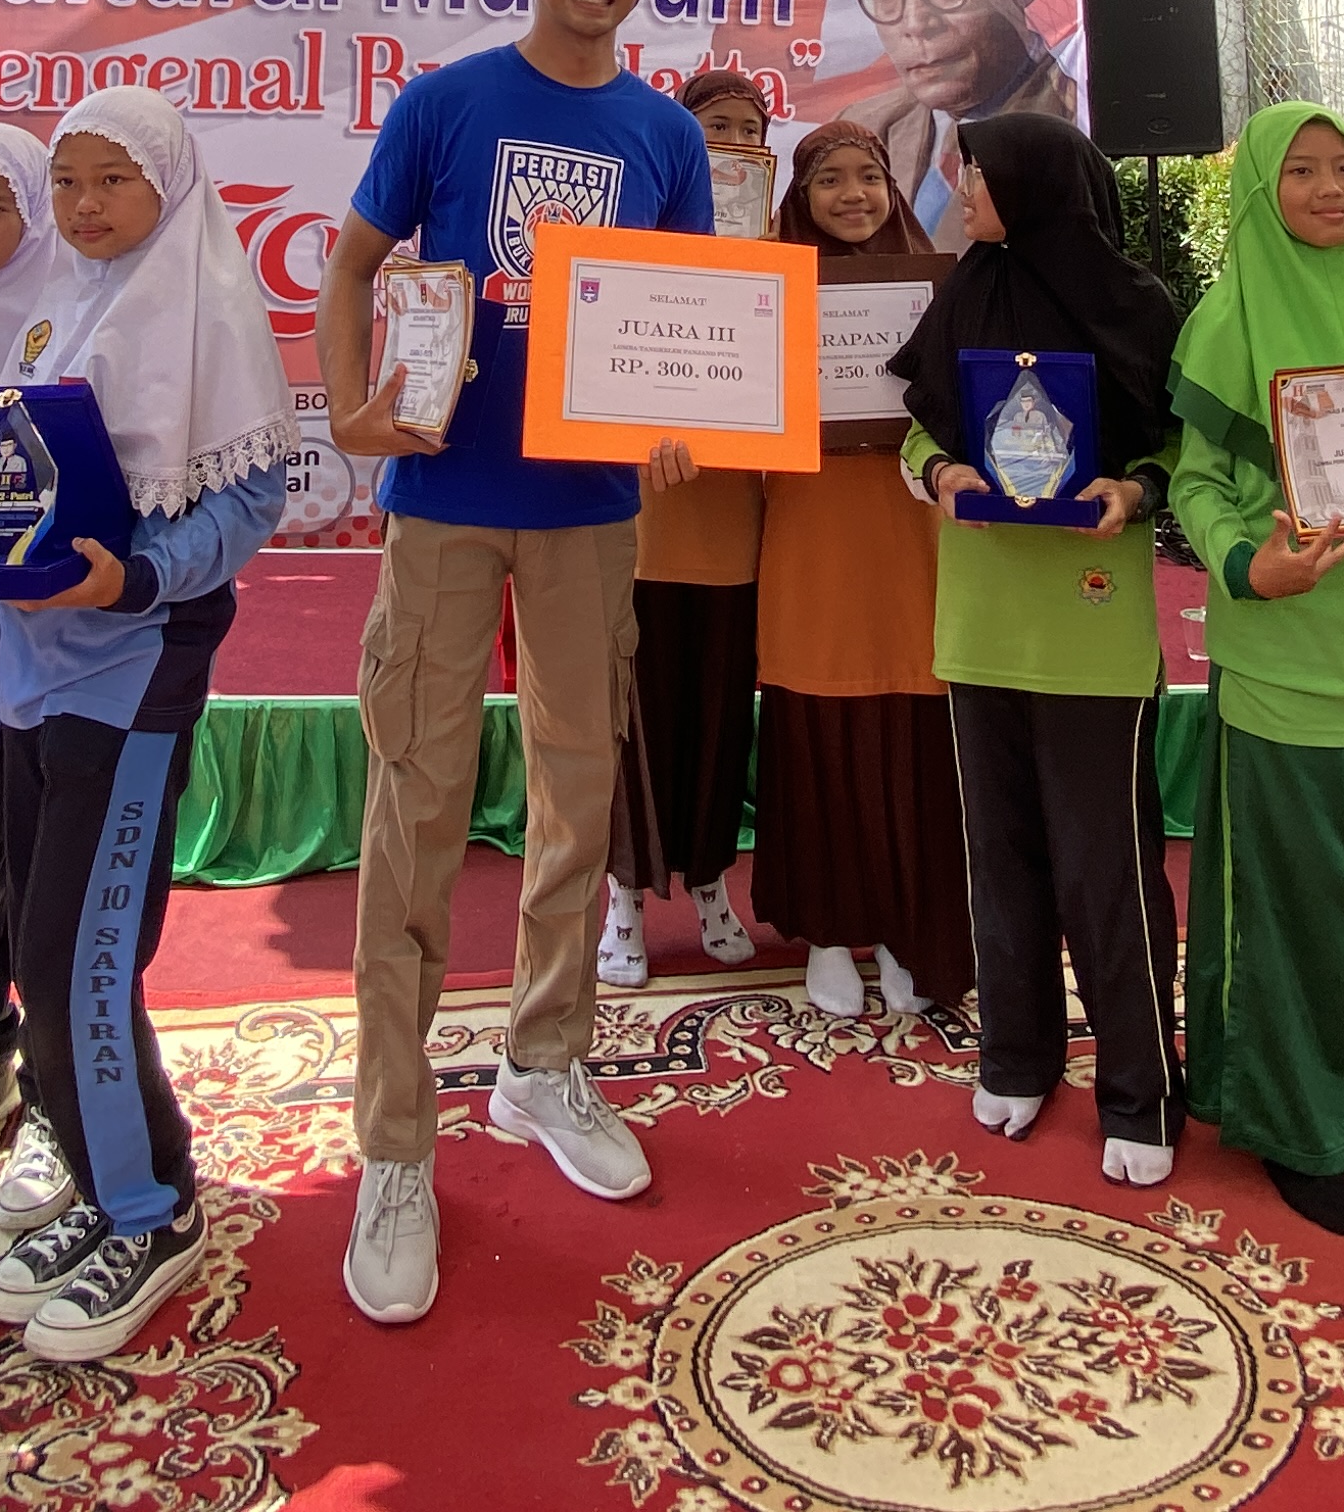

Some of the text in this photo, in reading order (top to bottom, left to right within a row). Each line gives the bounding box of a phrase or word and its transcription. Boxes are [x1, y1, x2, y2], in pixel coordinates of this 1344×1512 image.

[512, 153, 608, 190] PERBASI
[649, 293, 707, 306] SELAMAT
[822, 309, 870, 318] SELAMAT
[618, 319, 737, 343] JUARA III
[820, 331, 890, 347] RAPAN
[609, 357, 743, 382] RP. 300. 000
[834, 364, 870, 379] 250.
[108, 800, 144, 870] SDN
[97, 884, 130, 911] 10
[89, 926, 124, 1084] SAPIRAN
